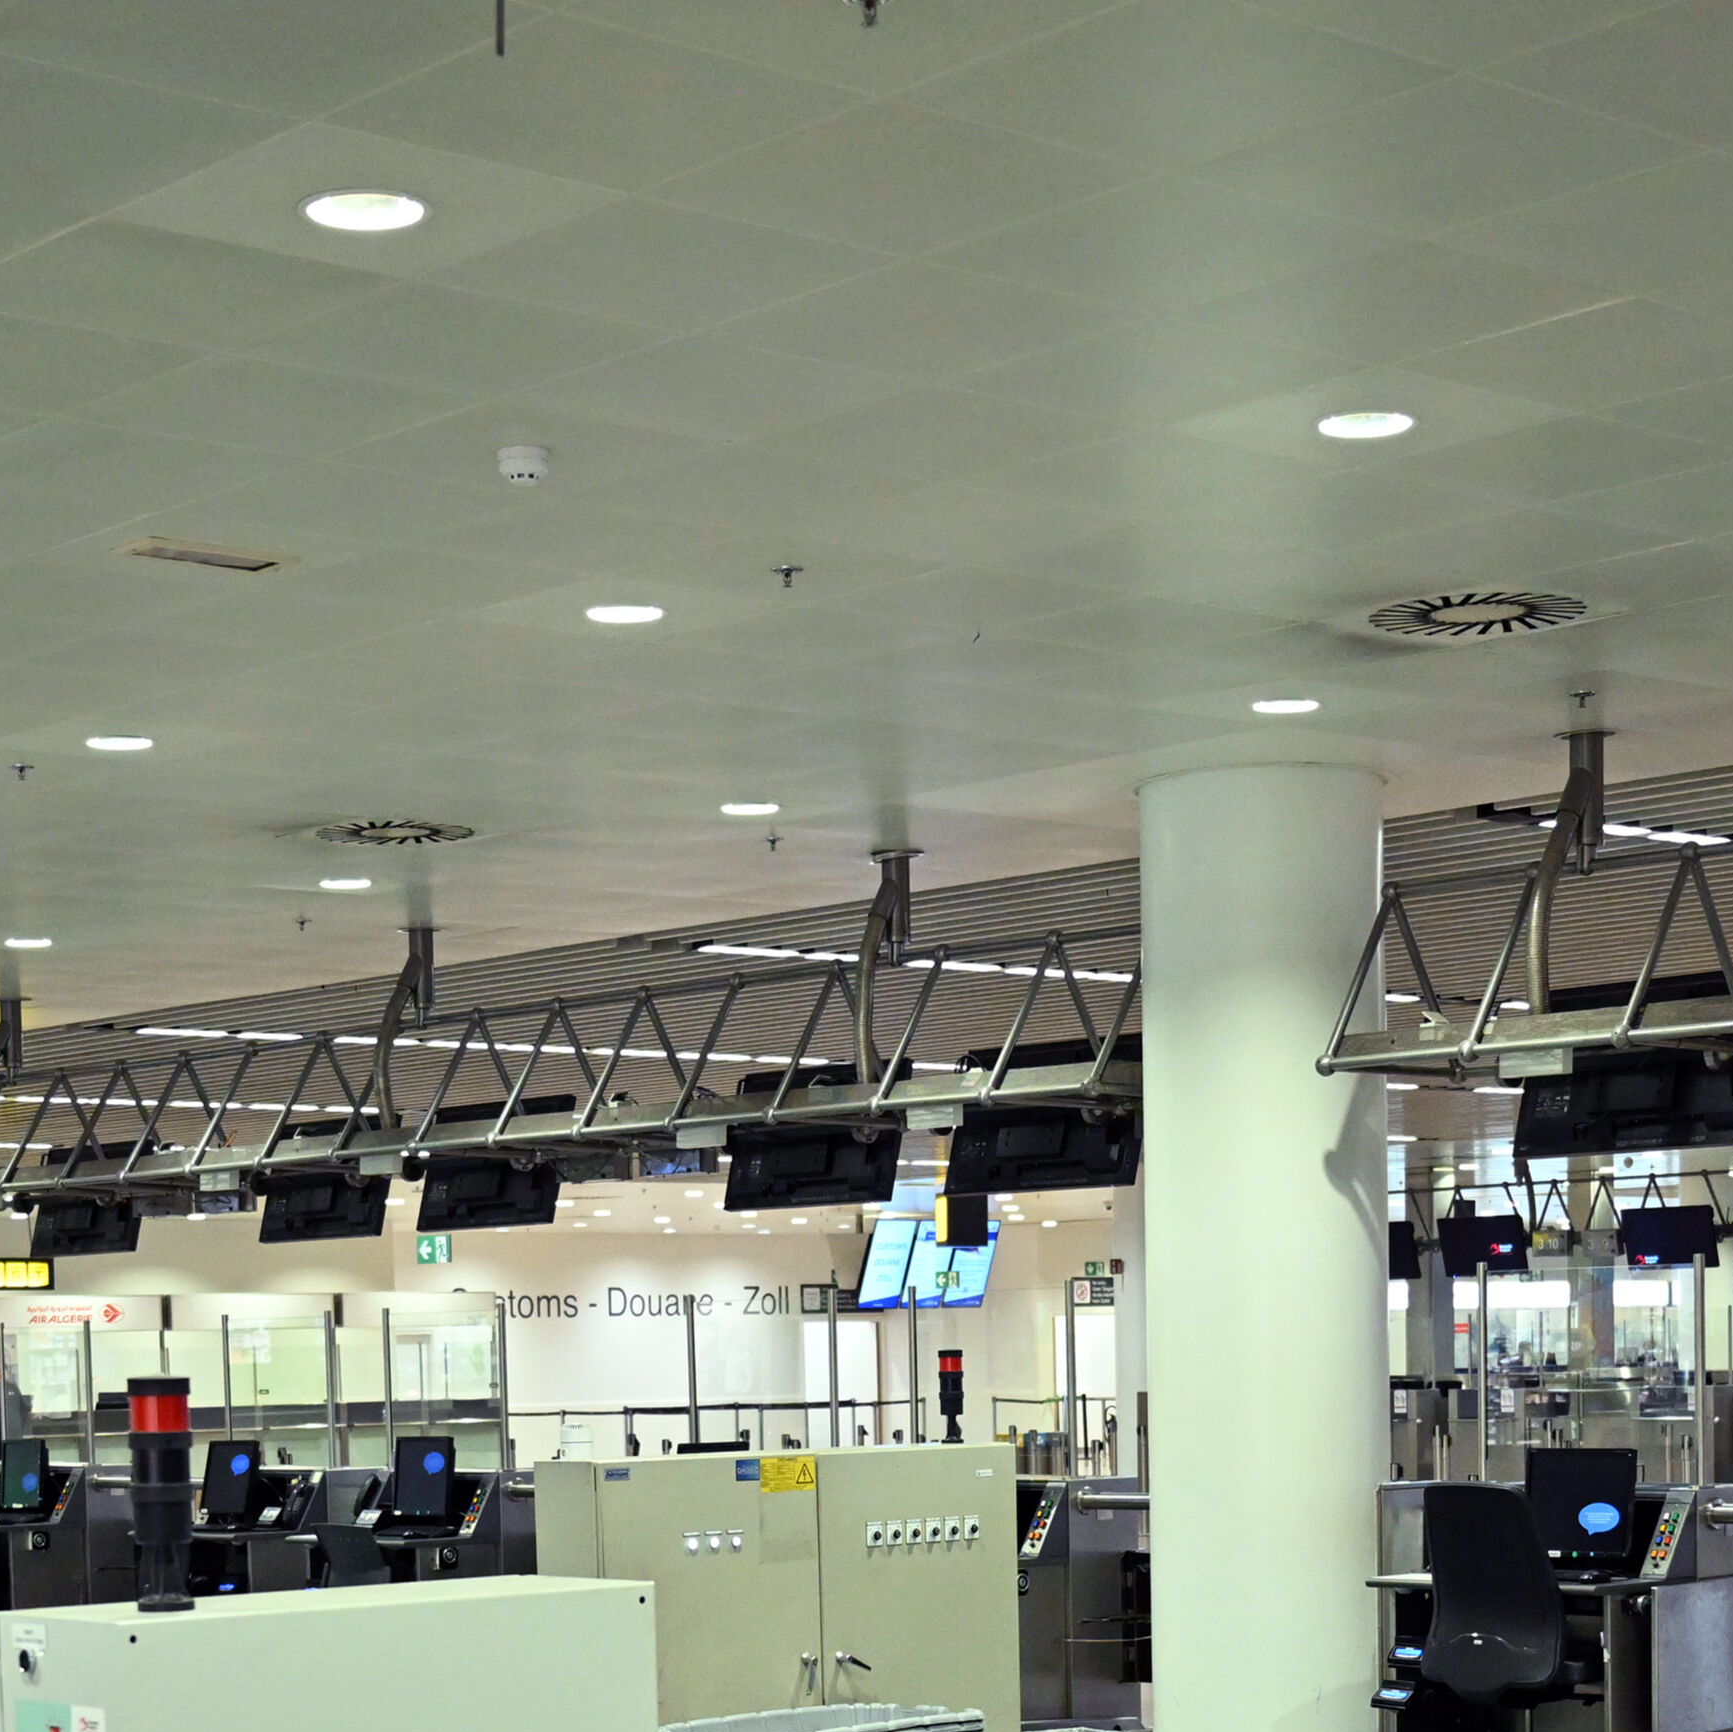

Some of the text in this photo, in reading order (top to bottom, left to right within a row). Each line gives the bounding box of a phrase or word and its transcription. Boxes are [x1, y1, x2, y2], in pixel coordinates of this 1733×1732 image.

[608, 1287, 713, 1317] Douane
[743, 1285, 789, 1315] Zoll
[28, 1314, 47, 1324] AIR
